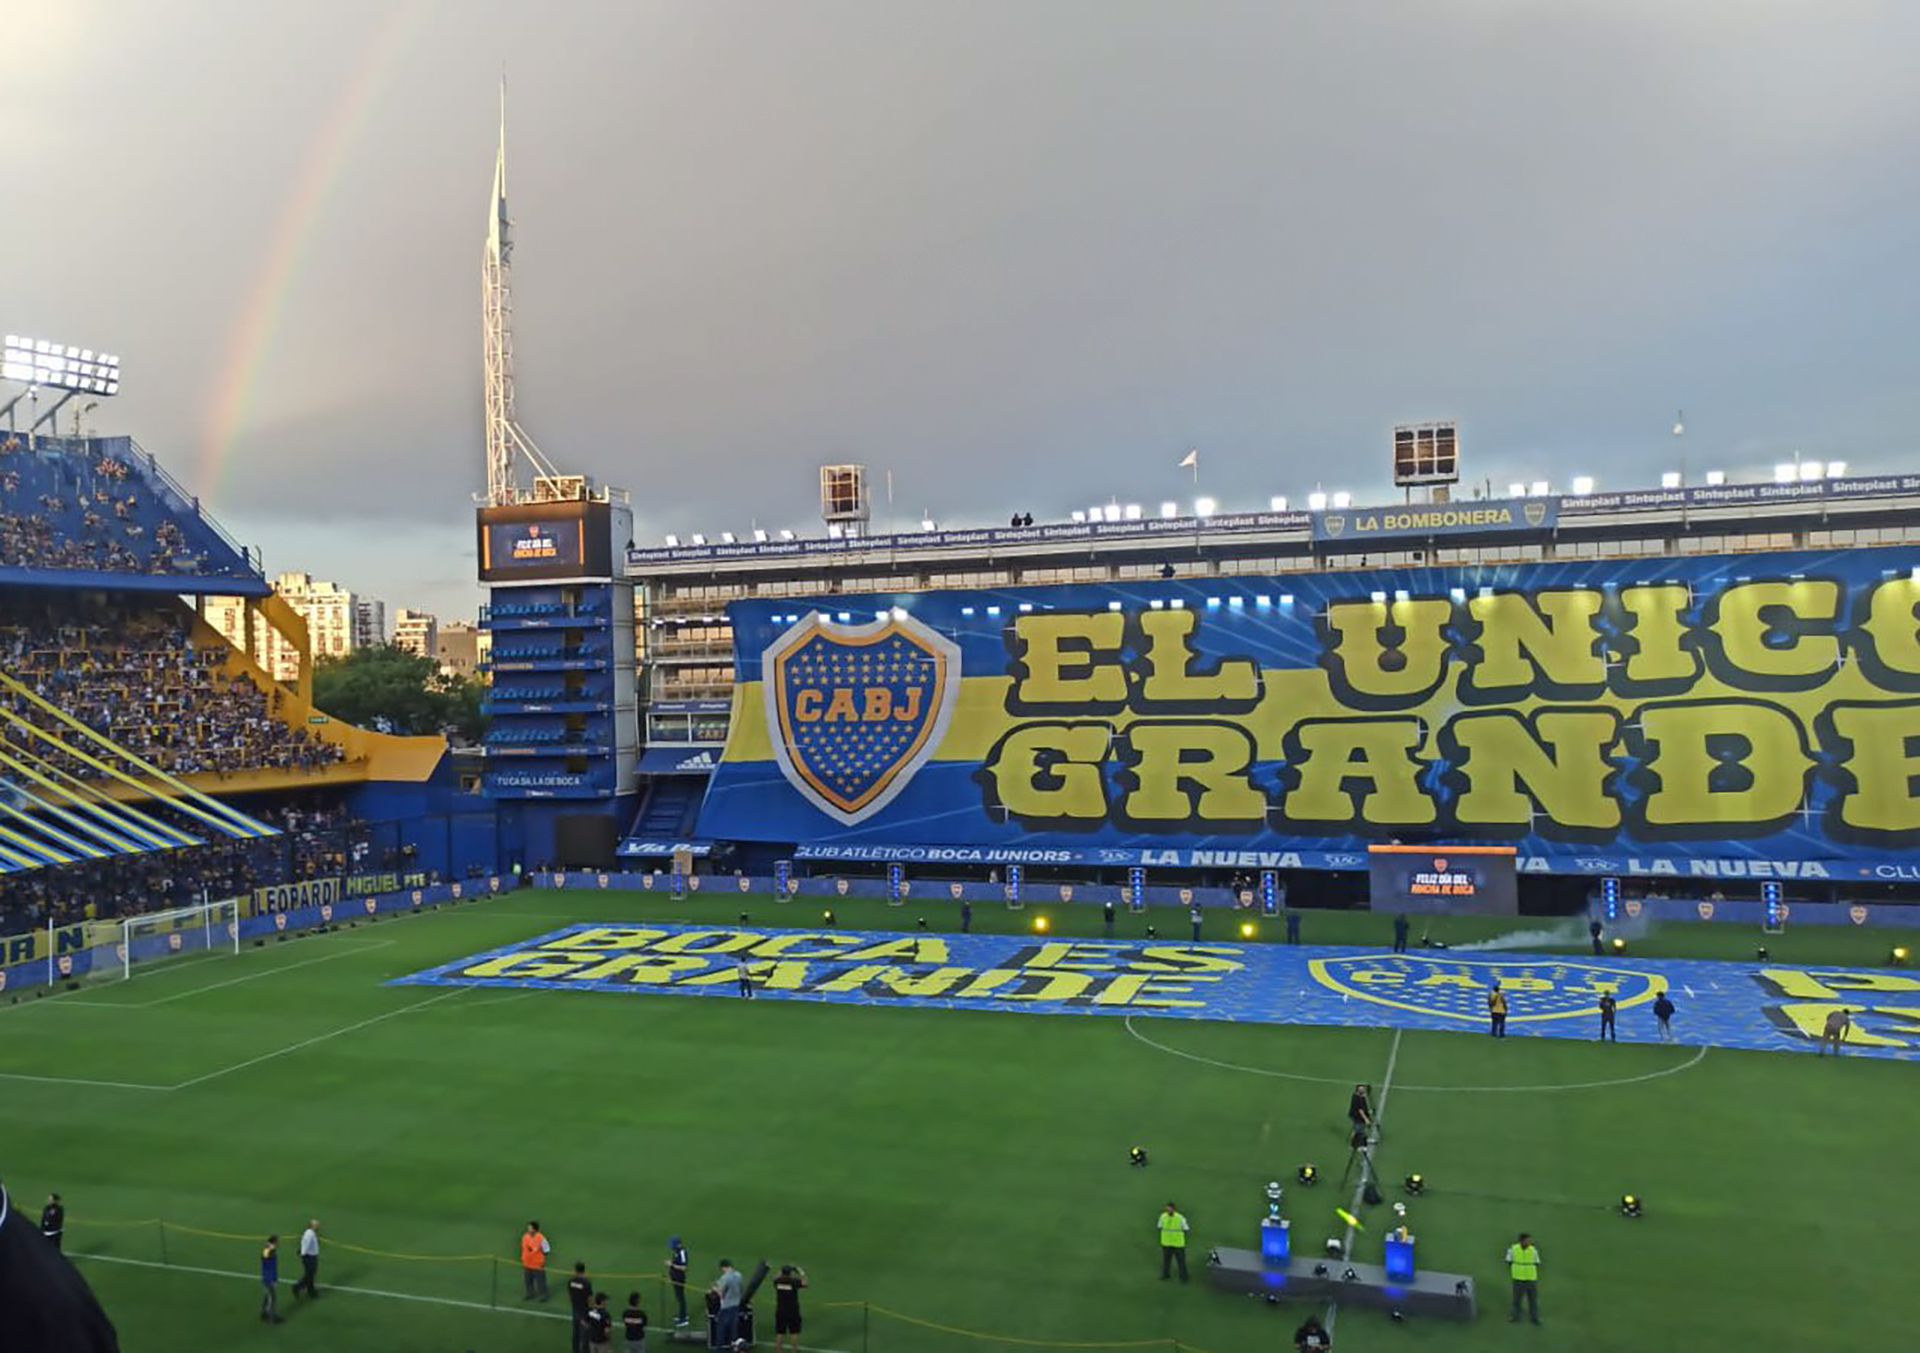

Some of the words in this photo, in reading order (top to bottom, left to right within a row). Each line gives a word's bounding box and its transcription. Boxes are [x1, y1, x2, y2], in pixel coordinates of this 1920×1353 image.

[1624, 491, 1685, 504] Sinteplast
[1693, 487, 1755, 500] Sinteplast
[1759, 484, 1823, 497] Sinteplast
[1832, 480, 1897, 492] Sinteplast
[1356, 515, 1378, 531] LA
[1384, 508, 1512, 530] BOMBONERA
[1012, 607, 1262, 705] EL
[795, 687, 922, 722] CABJ
[927, 848, 981, 860] BOCA
[985, 849, 1071, 862] JUNIORS
[1141, 850, 1180, 865] LA
[1190, 850, 1302, 867] NUEVA
[1627, 858, 1679, 875] LA
[1690, 859, 1830, 878] NUEVA
[540, 928, 949, 963] BOCA
[463, 951, 1222, 1006] GRANDE
[1350, 971, 1620, 993] CABJ
